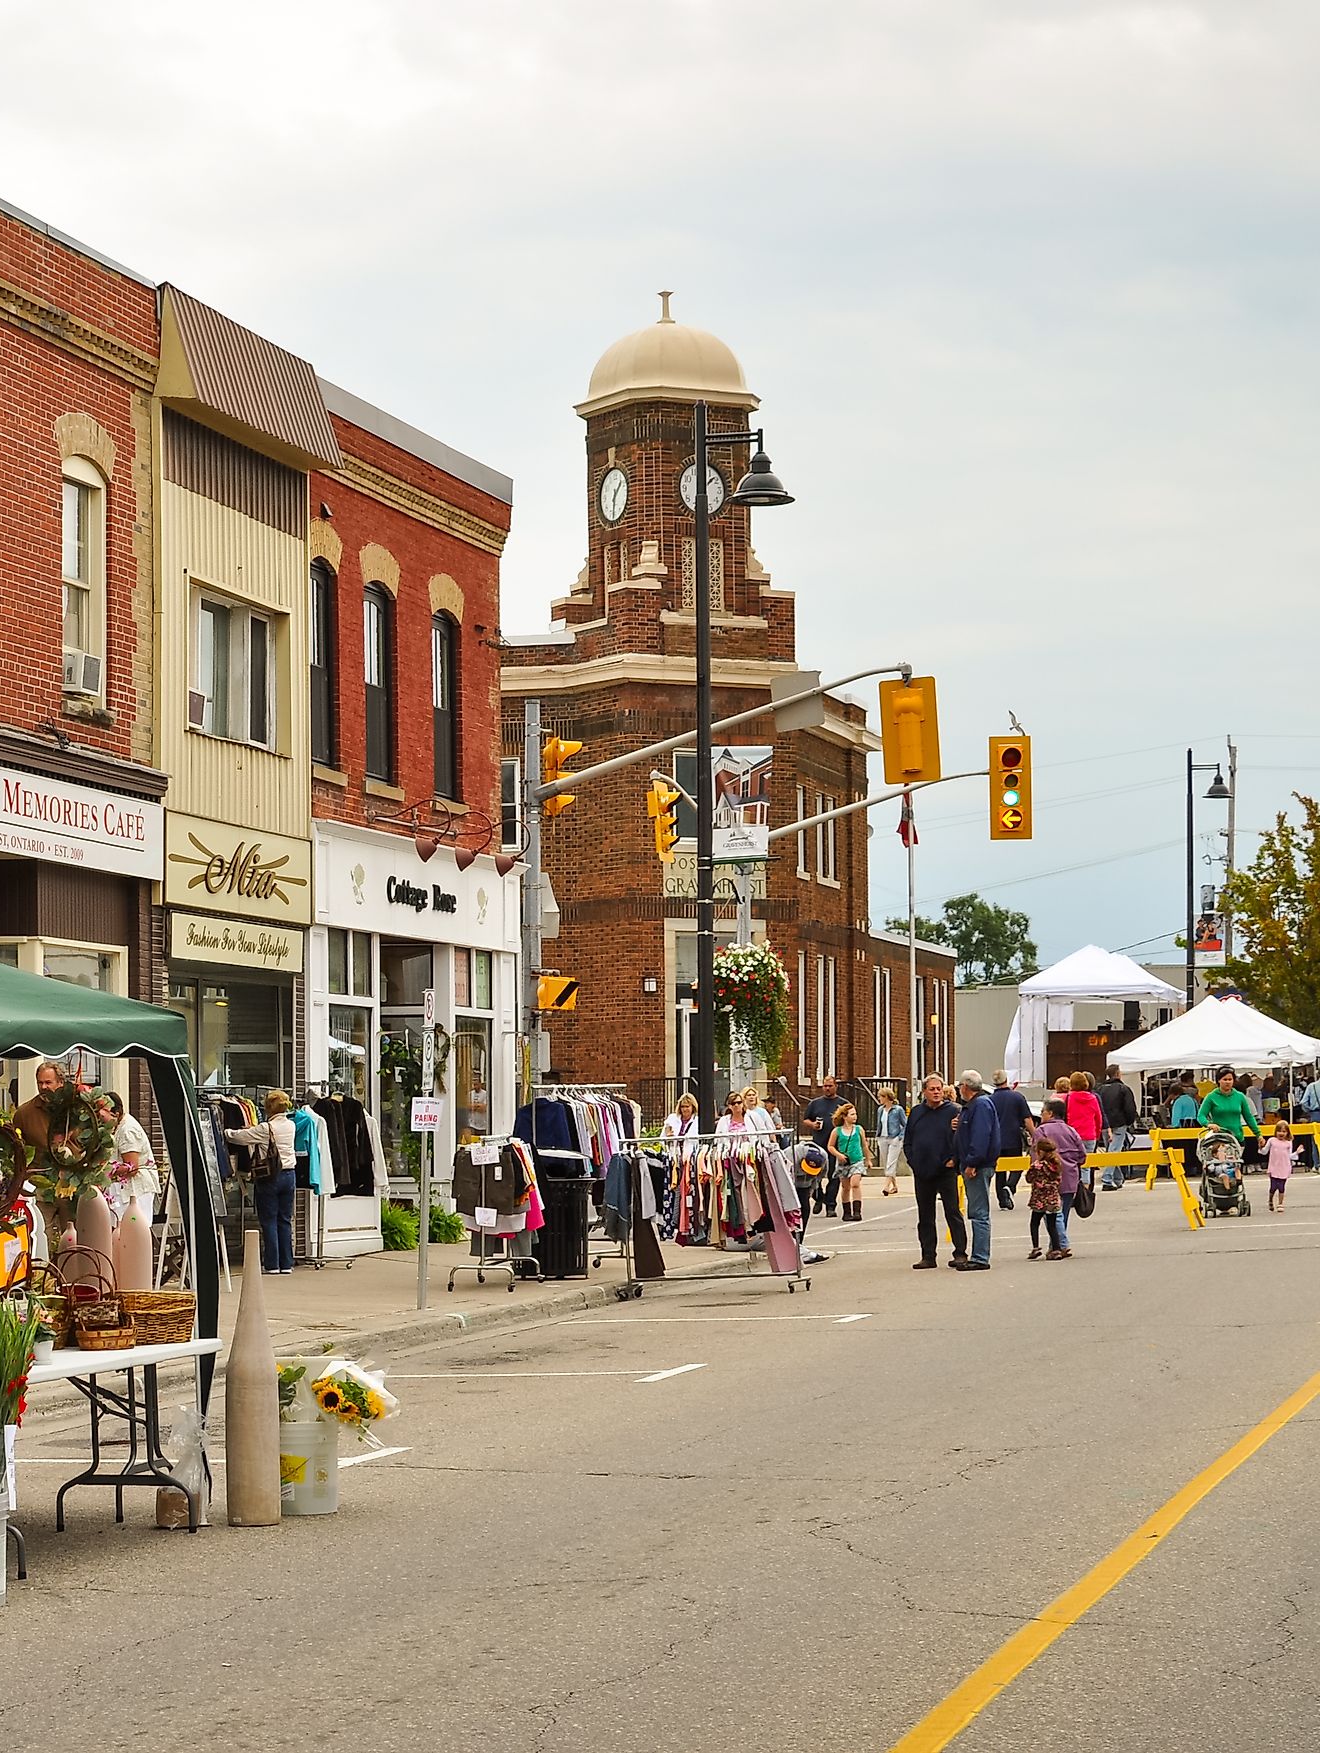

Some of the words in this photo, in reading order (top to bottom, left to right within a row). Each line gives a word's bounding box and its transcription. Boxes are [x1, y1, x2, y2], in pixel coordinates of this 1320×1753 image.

[2, 778, 98, 832] MEMORIES
[10, 837, 45, 853] ONTARIO
[54, 845, 69, 858] EST.
[205, 841, 278, 900] Mia
[387, 875, 429, 912] Cottage
[186, 922, 220, 948] Fashion
[221, 928, 237, 950] For
[238, 930, 257, 953] Your
[258, 932, 290, 966] Lifestyle
